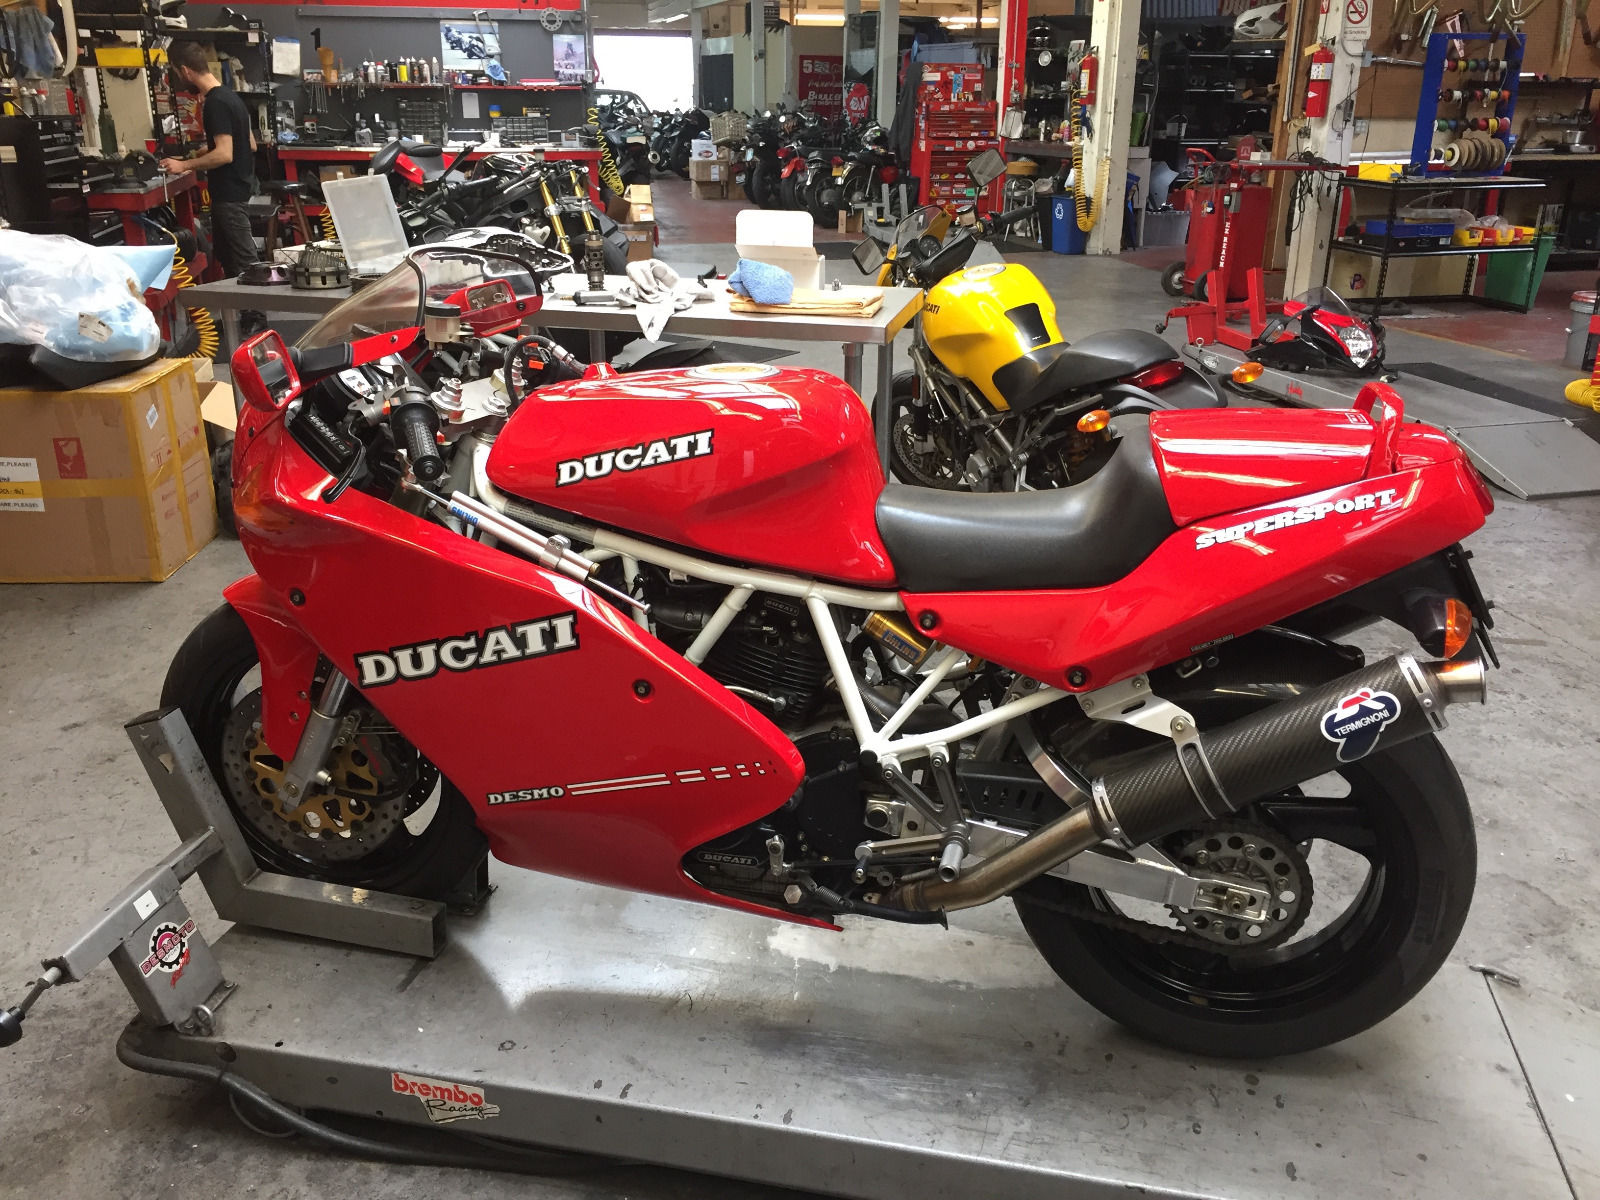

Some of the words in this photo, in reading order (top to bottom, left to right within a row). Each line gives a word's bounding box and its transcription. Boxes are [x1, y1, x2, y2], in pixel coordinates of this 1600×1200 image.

[557, 429, 713, 487] DUCATI
[1196, 489, 1396, 550] SUPERSPORT
[357, 613, 578, 687] DUCATI
[1334, 709, 1391, 736] TERMIGNONI
[488, 786, 564, 804] DESMO
[703, 853, 753, 865] DUCATI
[141, 919, 195, 975] DESMOTO
[393, 1073, 484, 1107] brembo
[425, 1098, 486, 1119] Racing
